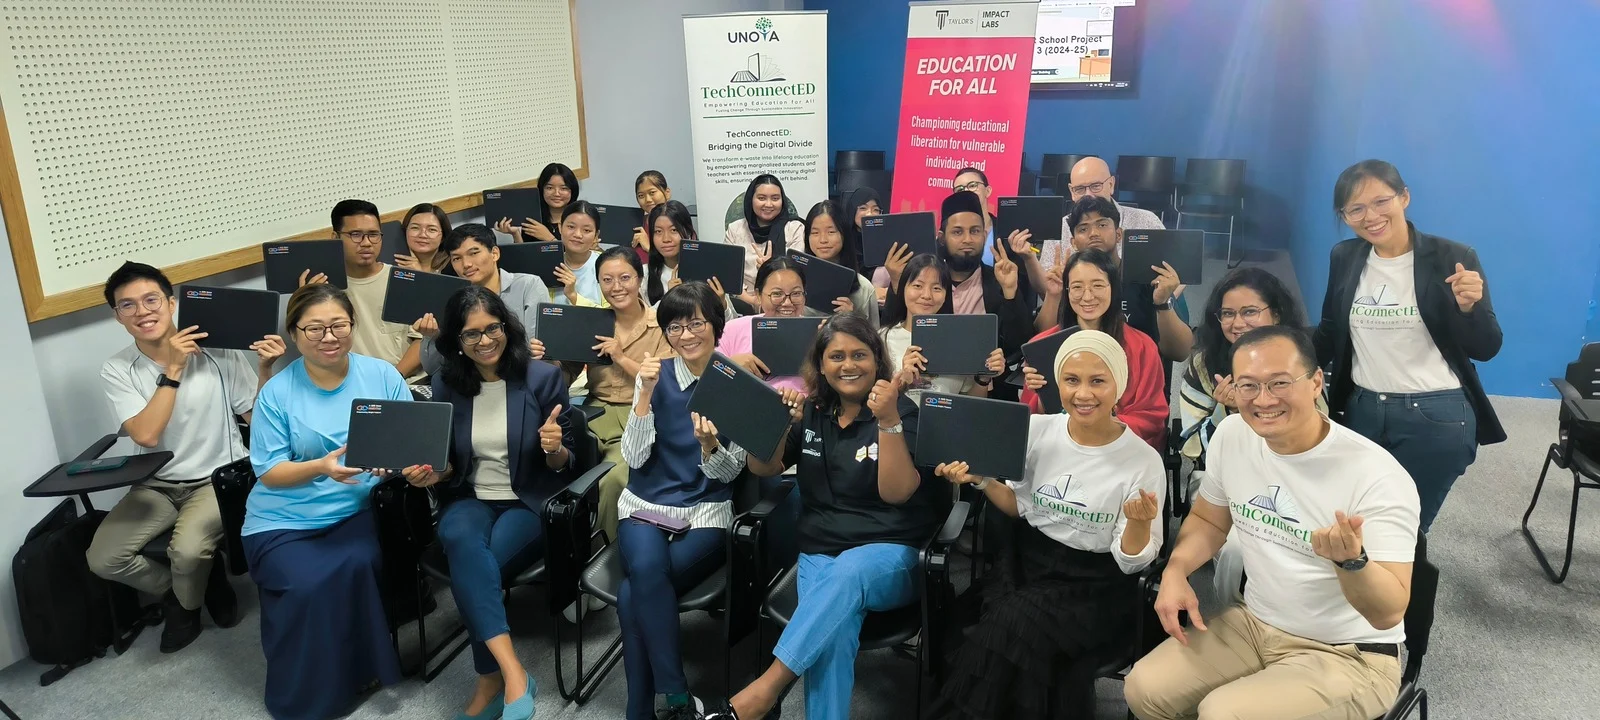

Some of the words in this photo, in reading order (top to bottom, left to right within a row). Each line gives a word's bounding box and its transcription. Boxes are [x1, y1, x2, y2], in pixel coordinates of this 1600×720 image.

[982, 10, 1010, 18] IMPACT
[1039, 36, 1068, 44] School
[1071, 35, 1102, 45] Project
[1036, 46, 1042, 54] 3
[1044, 46, 1089, 56] (2024-25)
[916, 53, 1018, 75] EDUCATION
[700, 82, 816, 99] TechConnectED
[928, 78, 964, 96] FOR
[966, 77, 998, 95] ALL
[911, 116, 960, 132] Championing
[962, 118, 1010, 132] educational
[726, 128, 792, 138] TechConnectED:
[708, 142, 742, 152] Bridging
[744, 142, 758, 150] the
[760, 140, 786, 150] Digital
[788, 140, 813, 148] Divide
[910, 134, 948, 149] liberation
[950, 137, 960, 150] for
[962, 138, 1006, 153] vulnerable
[926, 155, 969, 170] individuals
[970, 159, 986, 172] and
[1352, 306, 1418, 317] ConnectE
[1031, 492, 1114, 524] hConnectED
[1228, 496, 1313, 544] echConnect
[1264, 528, 1298, 546] Education
